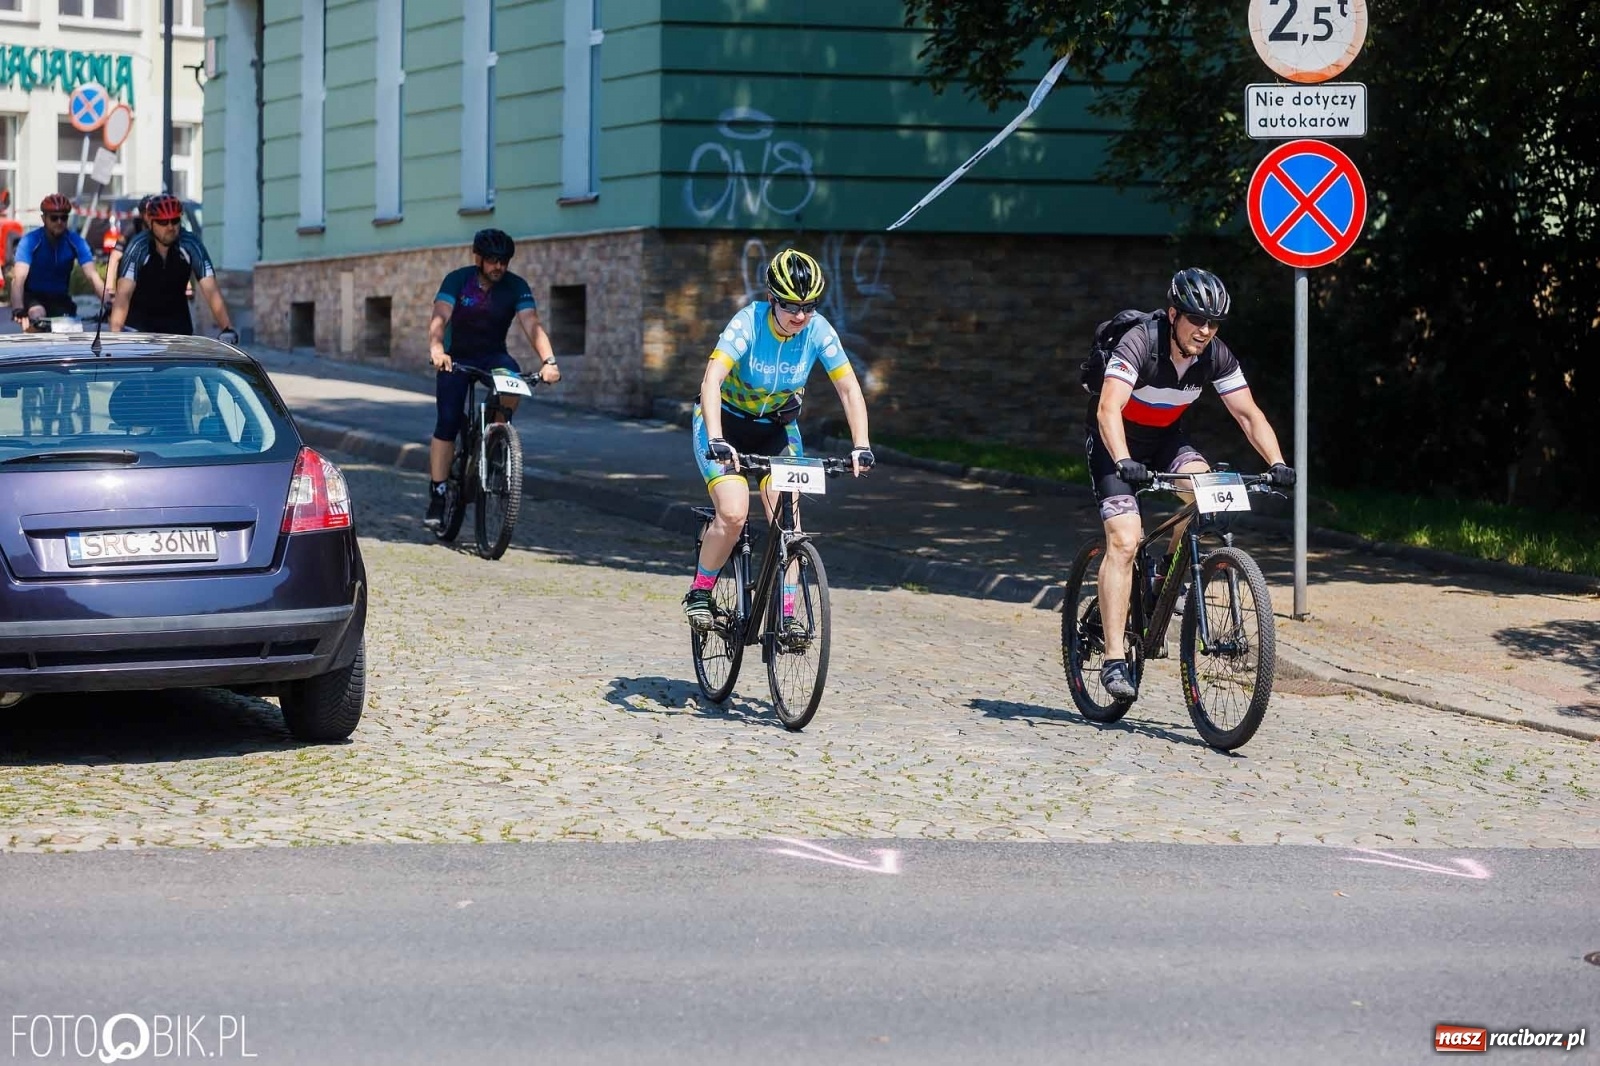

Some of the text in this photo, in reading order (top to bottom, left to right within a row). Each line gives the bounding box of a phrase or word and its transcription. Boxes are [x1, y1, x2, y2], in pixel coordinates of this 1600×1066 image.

[1255, 91, 1356, 110] Nie dotyczy
[1258, 112, 1350, 127] autokarów
[787, 472, 809, 484] 210
[1212, 491, 1234, 504] 164
[83, 529, 211, 557] SRC 36NW
